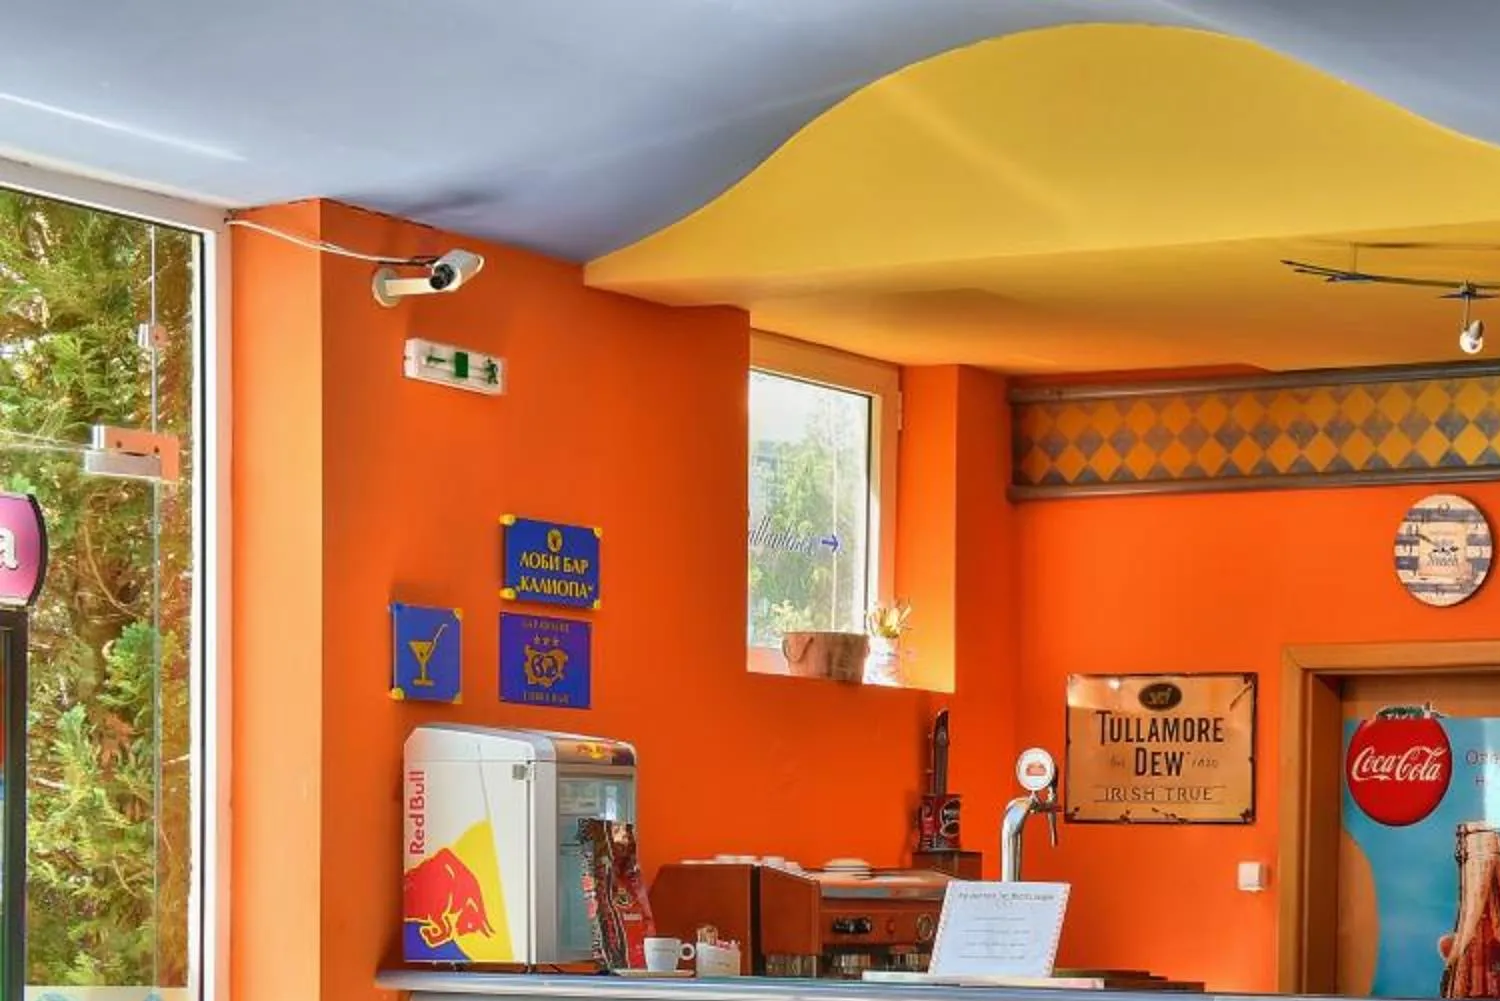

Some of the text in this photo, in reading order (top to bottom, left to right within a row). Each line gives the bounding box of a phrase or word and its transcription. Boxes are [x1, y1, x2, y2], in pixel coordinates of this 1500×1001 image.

[519, 551, 589, 575] ЛОБИ БАР
[1096, 710, 1225, 745] TULLAMORE
[1135, 747, 1185, 777] DEW
[1351, 745, 1447, 782] Coca-Cola
[1105, 786, 1213, 801] IRISH TRUE
[408, 770, 425, 855] Red Bull
